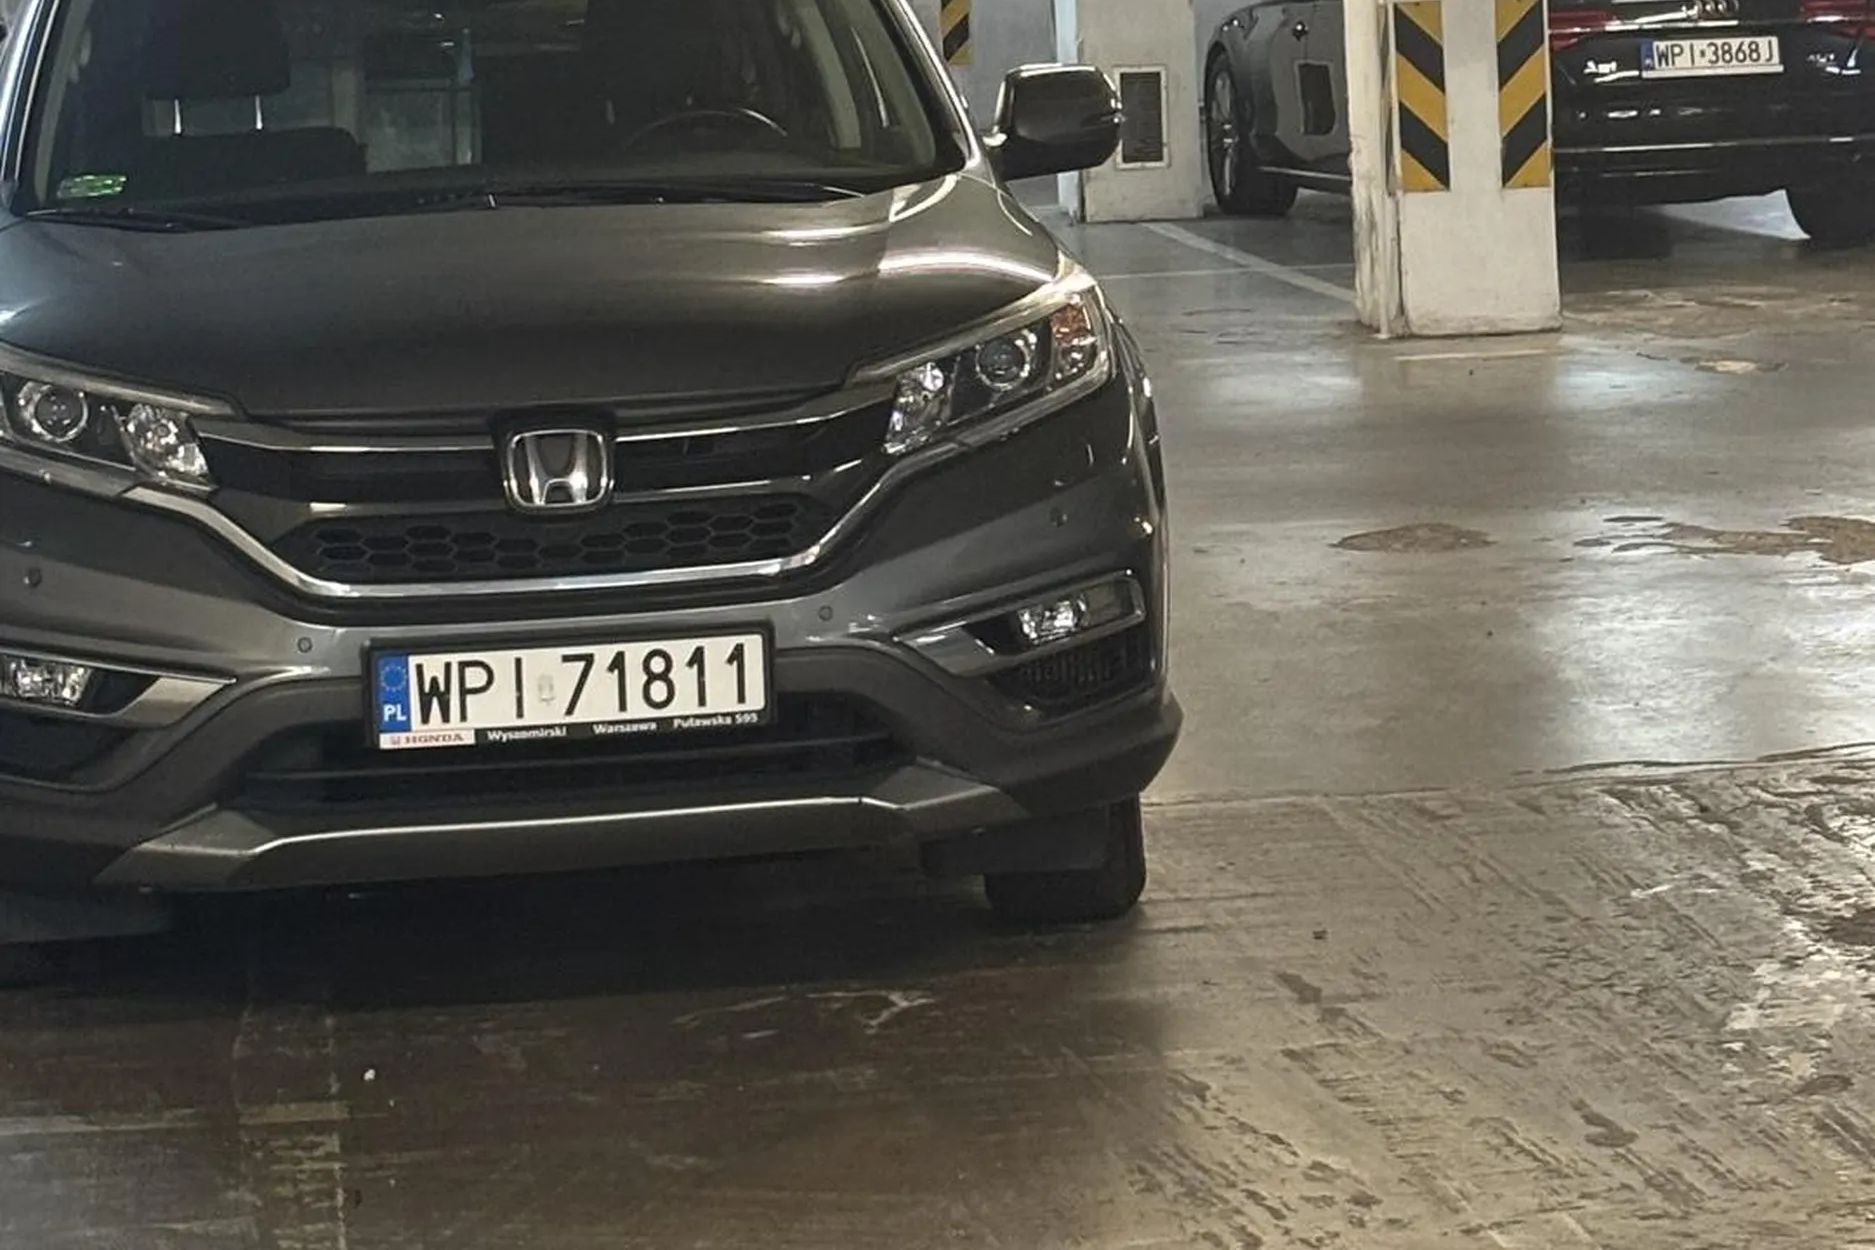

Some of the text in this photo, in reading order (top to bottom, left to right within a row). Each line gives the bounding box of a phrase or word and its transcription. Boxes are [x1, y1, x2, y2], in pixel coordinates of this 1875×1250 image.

[1656, 39, 1774, 66] WPI 3868J
[415, 643, 747, 725] WPI 71811
[384, 704, 407, 722] PL
[593, 721, 657, 734] Warszawa
